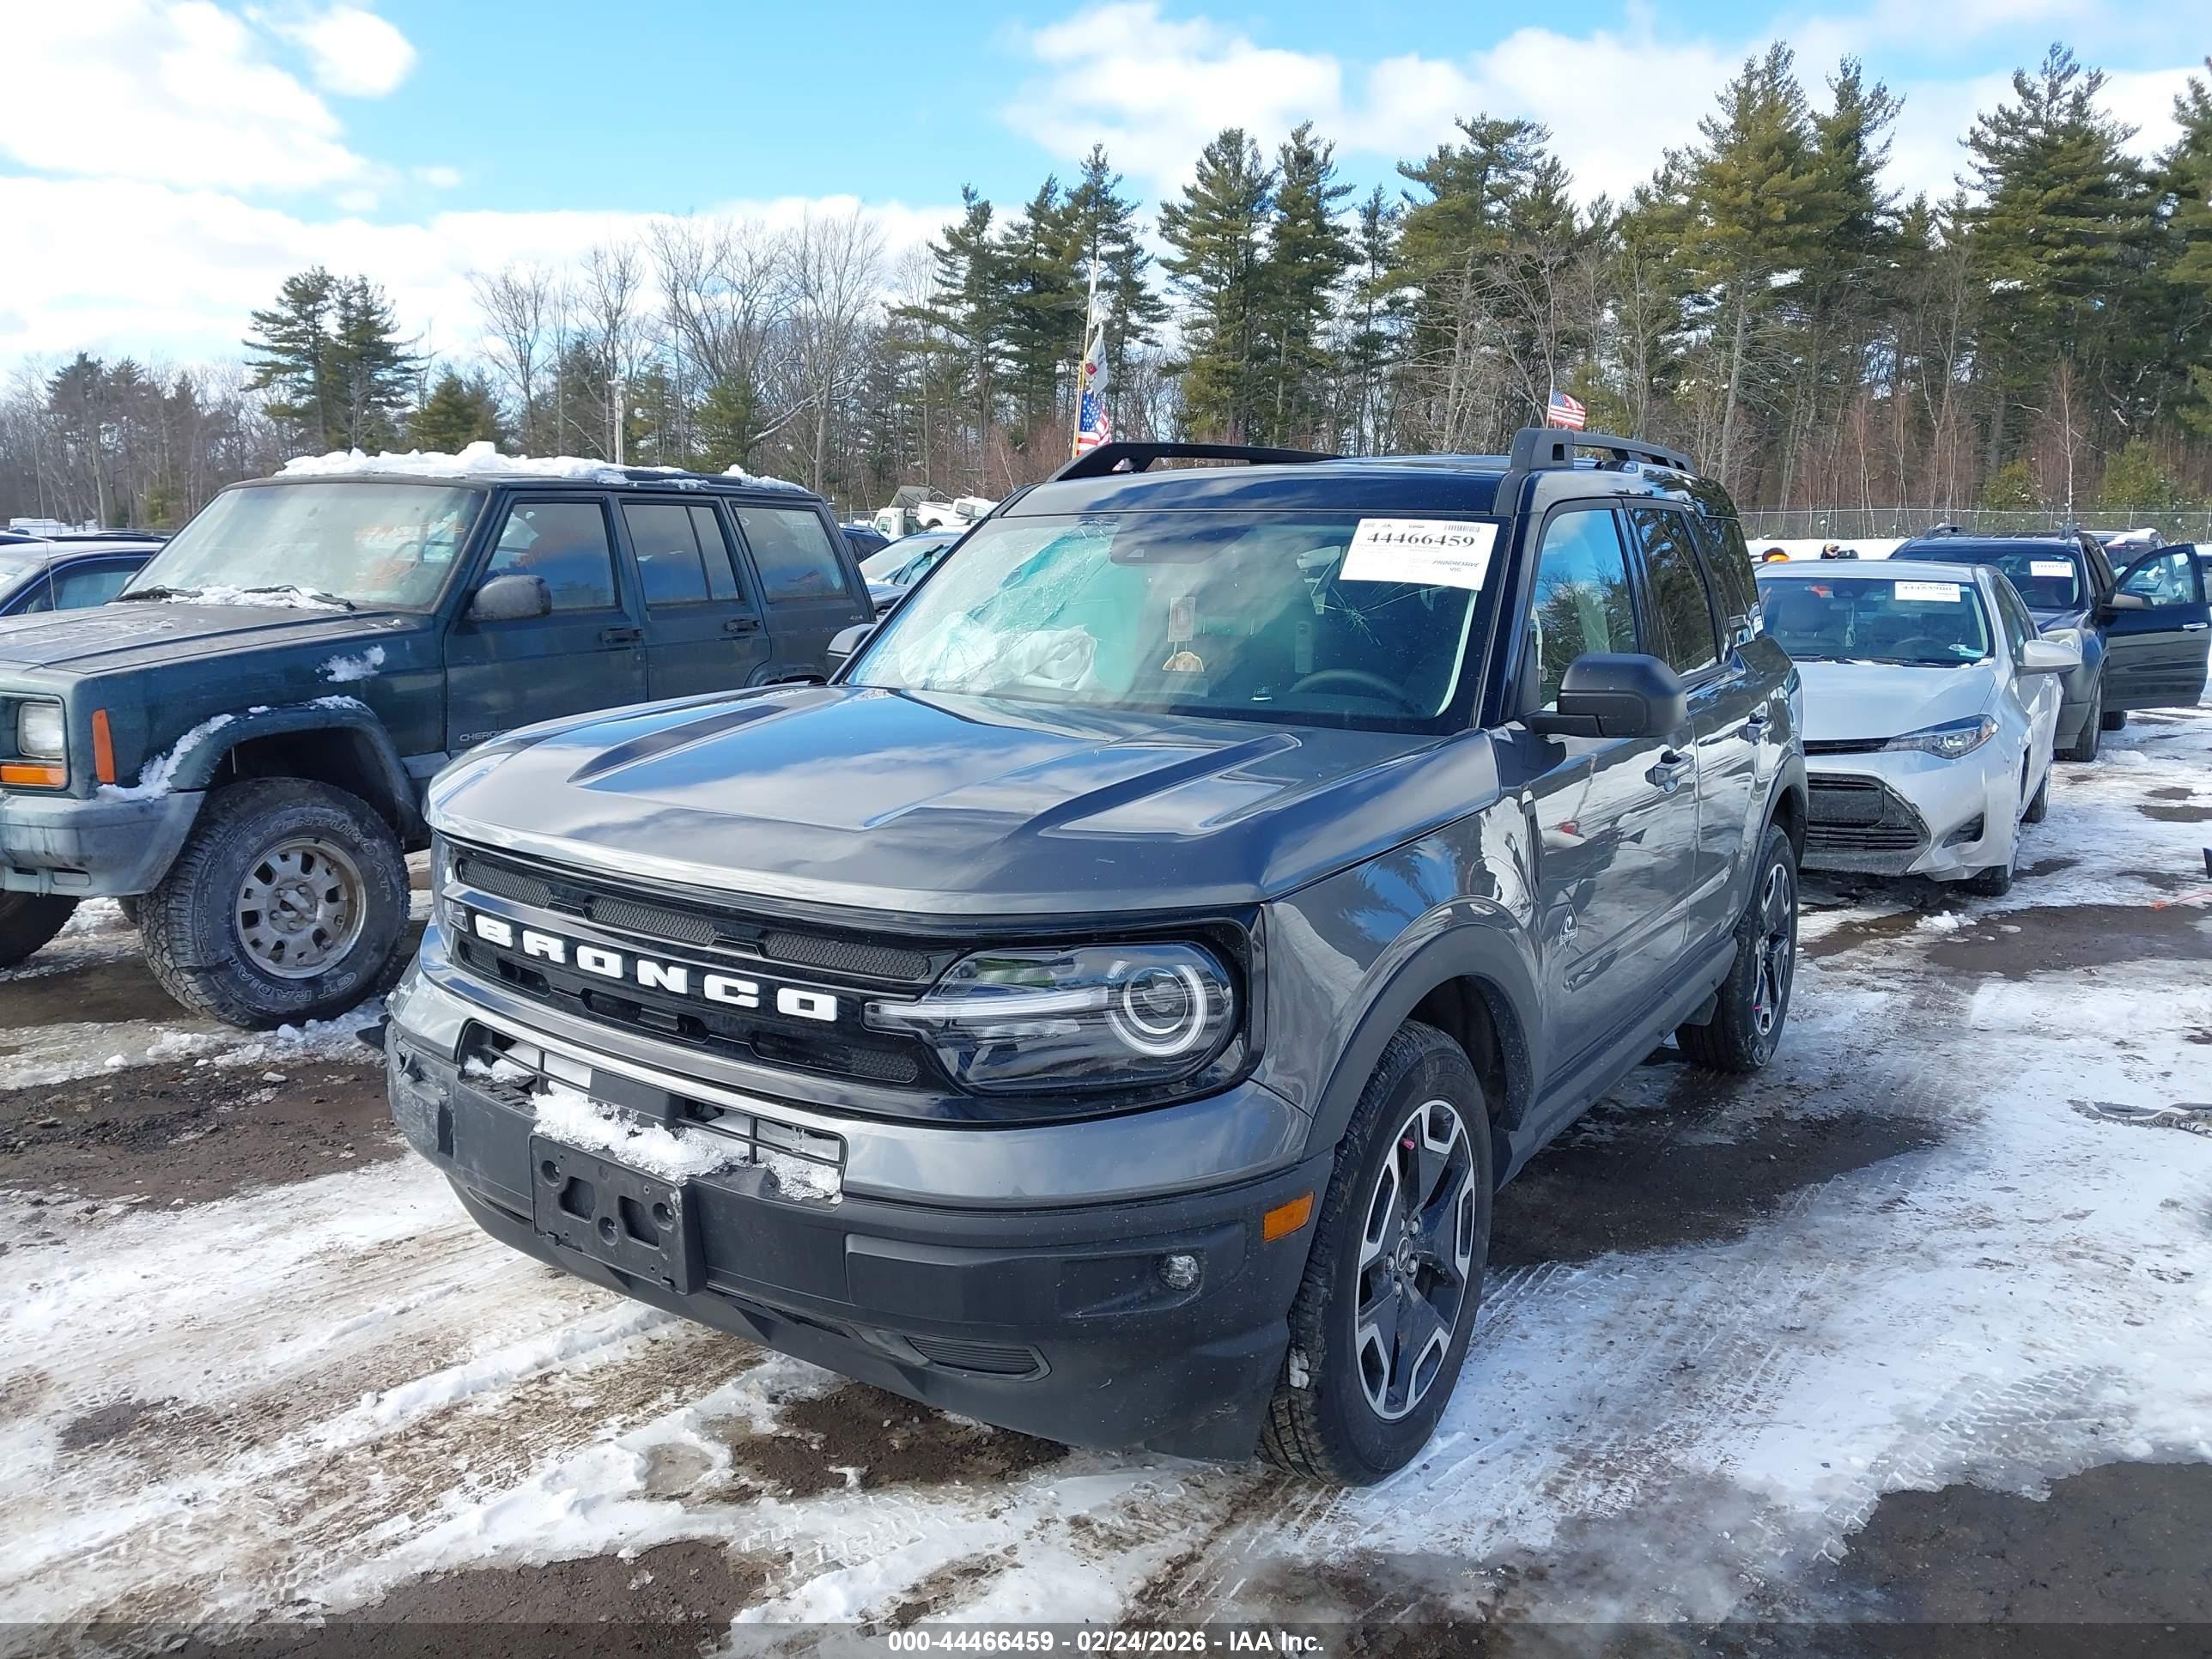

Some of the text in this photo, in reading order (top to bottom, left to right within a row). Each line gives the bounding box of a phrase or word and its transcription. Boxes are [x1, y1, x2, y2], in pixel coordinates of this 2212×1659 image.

[1367, 532, 1475, 548] 44466459
[459, 729, 512, 742] CHERO
[228, 955, 312, 1002] RADIAL
[475, 914, 837, 1021] BRONCO
